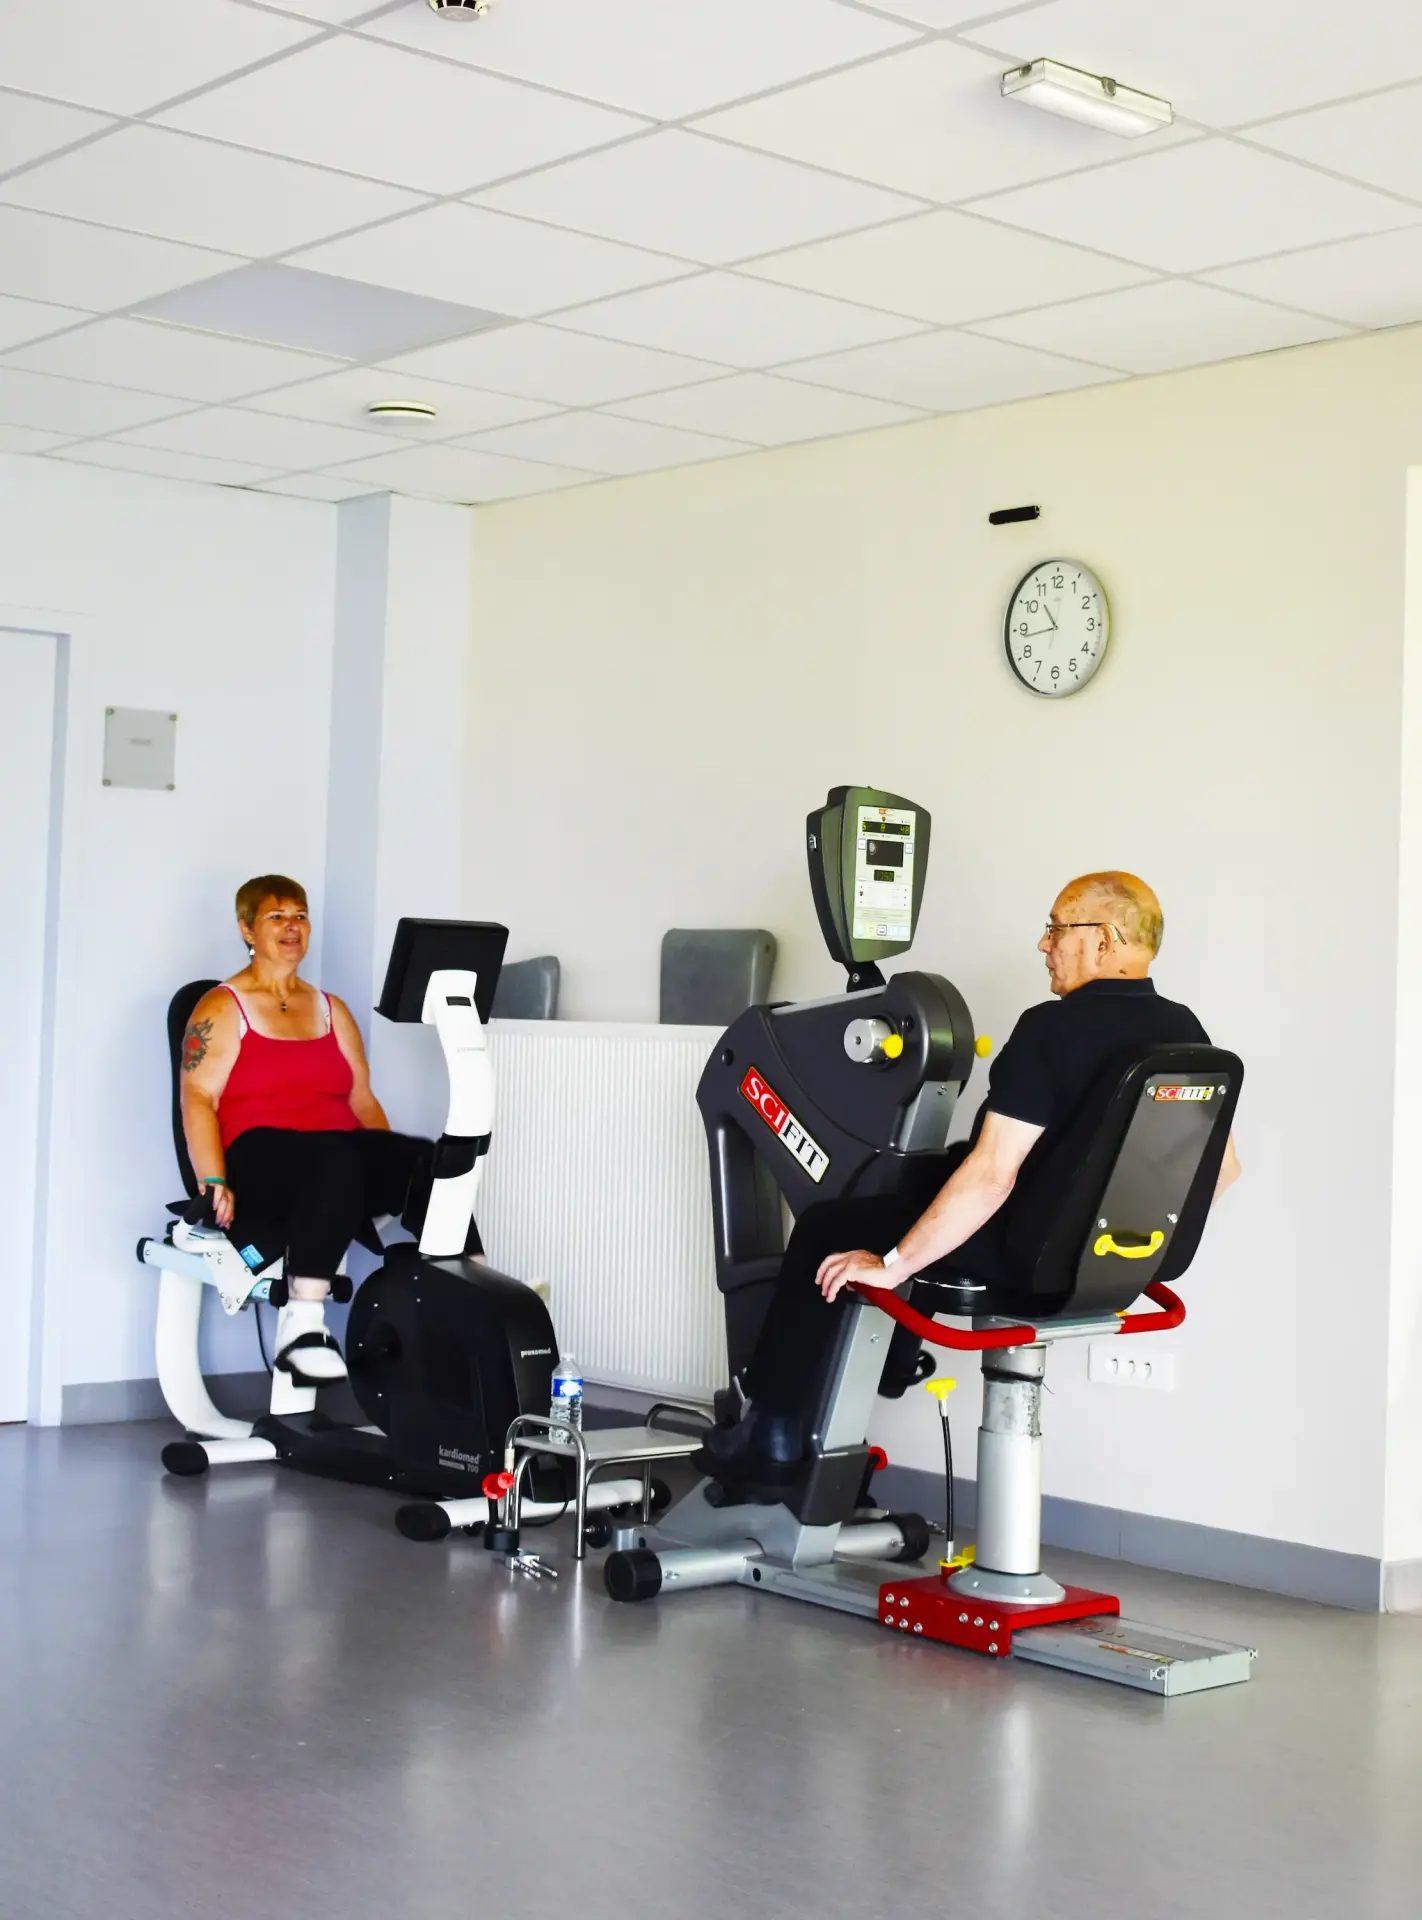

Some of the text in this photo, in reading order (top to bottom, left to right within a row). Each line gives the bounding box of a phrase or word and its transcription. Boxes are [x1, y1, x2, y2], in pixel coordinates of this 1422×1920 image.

[1051, 575, 1064, 588] 12
[1071, 581, 1076, 594] 1
[1036, 583, 1047, 596] 11
[1024, 600, 1039, 613] 10
[1081, 596, 1090, 609] 2
[1019, 622, 1028, 635] 9
[1086, 618, 1095, 631] 3
[1023, 645, 1032, 658] 8
[1081, 641, 1090, 654] 4
[1034, 660, 1042, 674] 7
[1068, 658, 1077, 672] 5
[1050, 666, 1060, 679] 6
[1156, 1087, 1206, 1099] SCIFIT
[746, 1077, 823, 1168] SCIFIT
[439, 1444, 480, 1465] kardiomed
